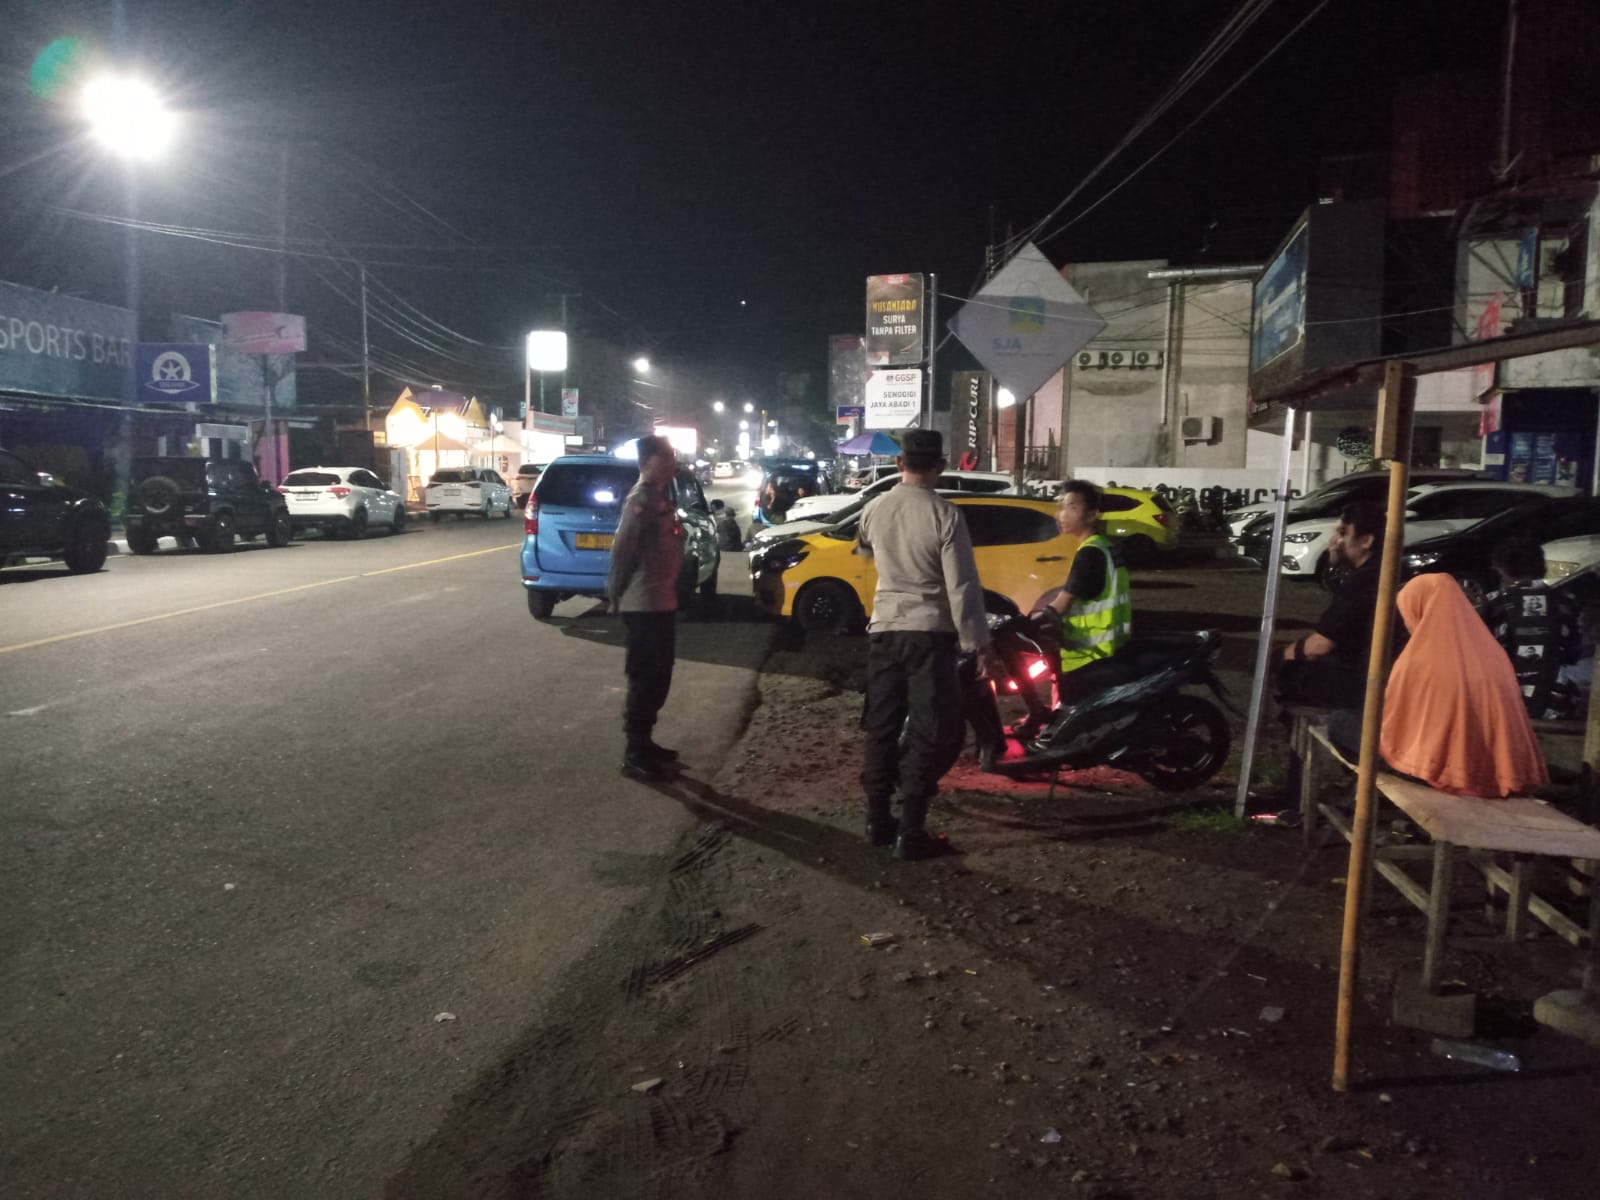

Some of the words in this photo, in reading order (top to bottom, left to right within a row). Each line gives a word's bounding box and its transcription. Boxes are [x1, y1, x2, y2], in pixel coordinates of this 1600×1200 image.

[882, 314, 906, 324] SURYA
[871, 326, 893, 336] TANPA
[894, 324, 917, 335] FILTER
[0, 315, 87, 361] SPORTS
[92, 333, 133, 366] BAR
[870, 401, 888, 409] JAYA
[888, 400, 911, 408] ABADI
[969, 376, 979, 419] CURL
[968, 420, 977, 448] RIP
